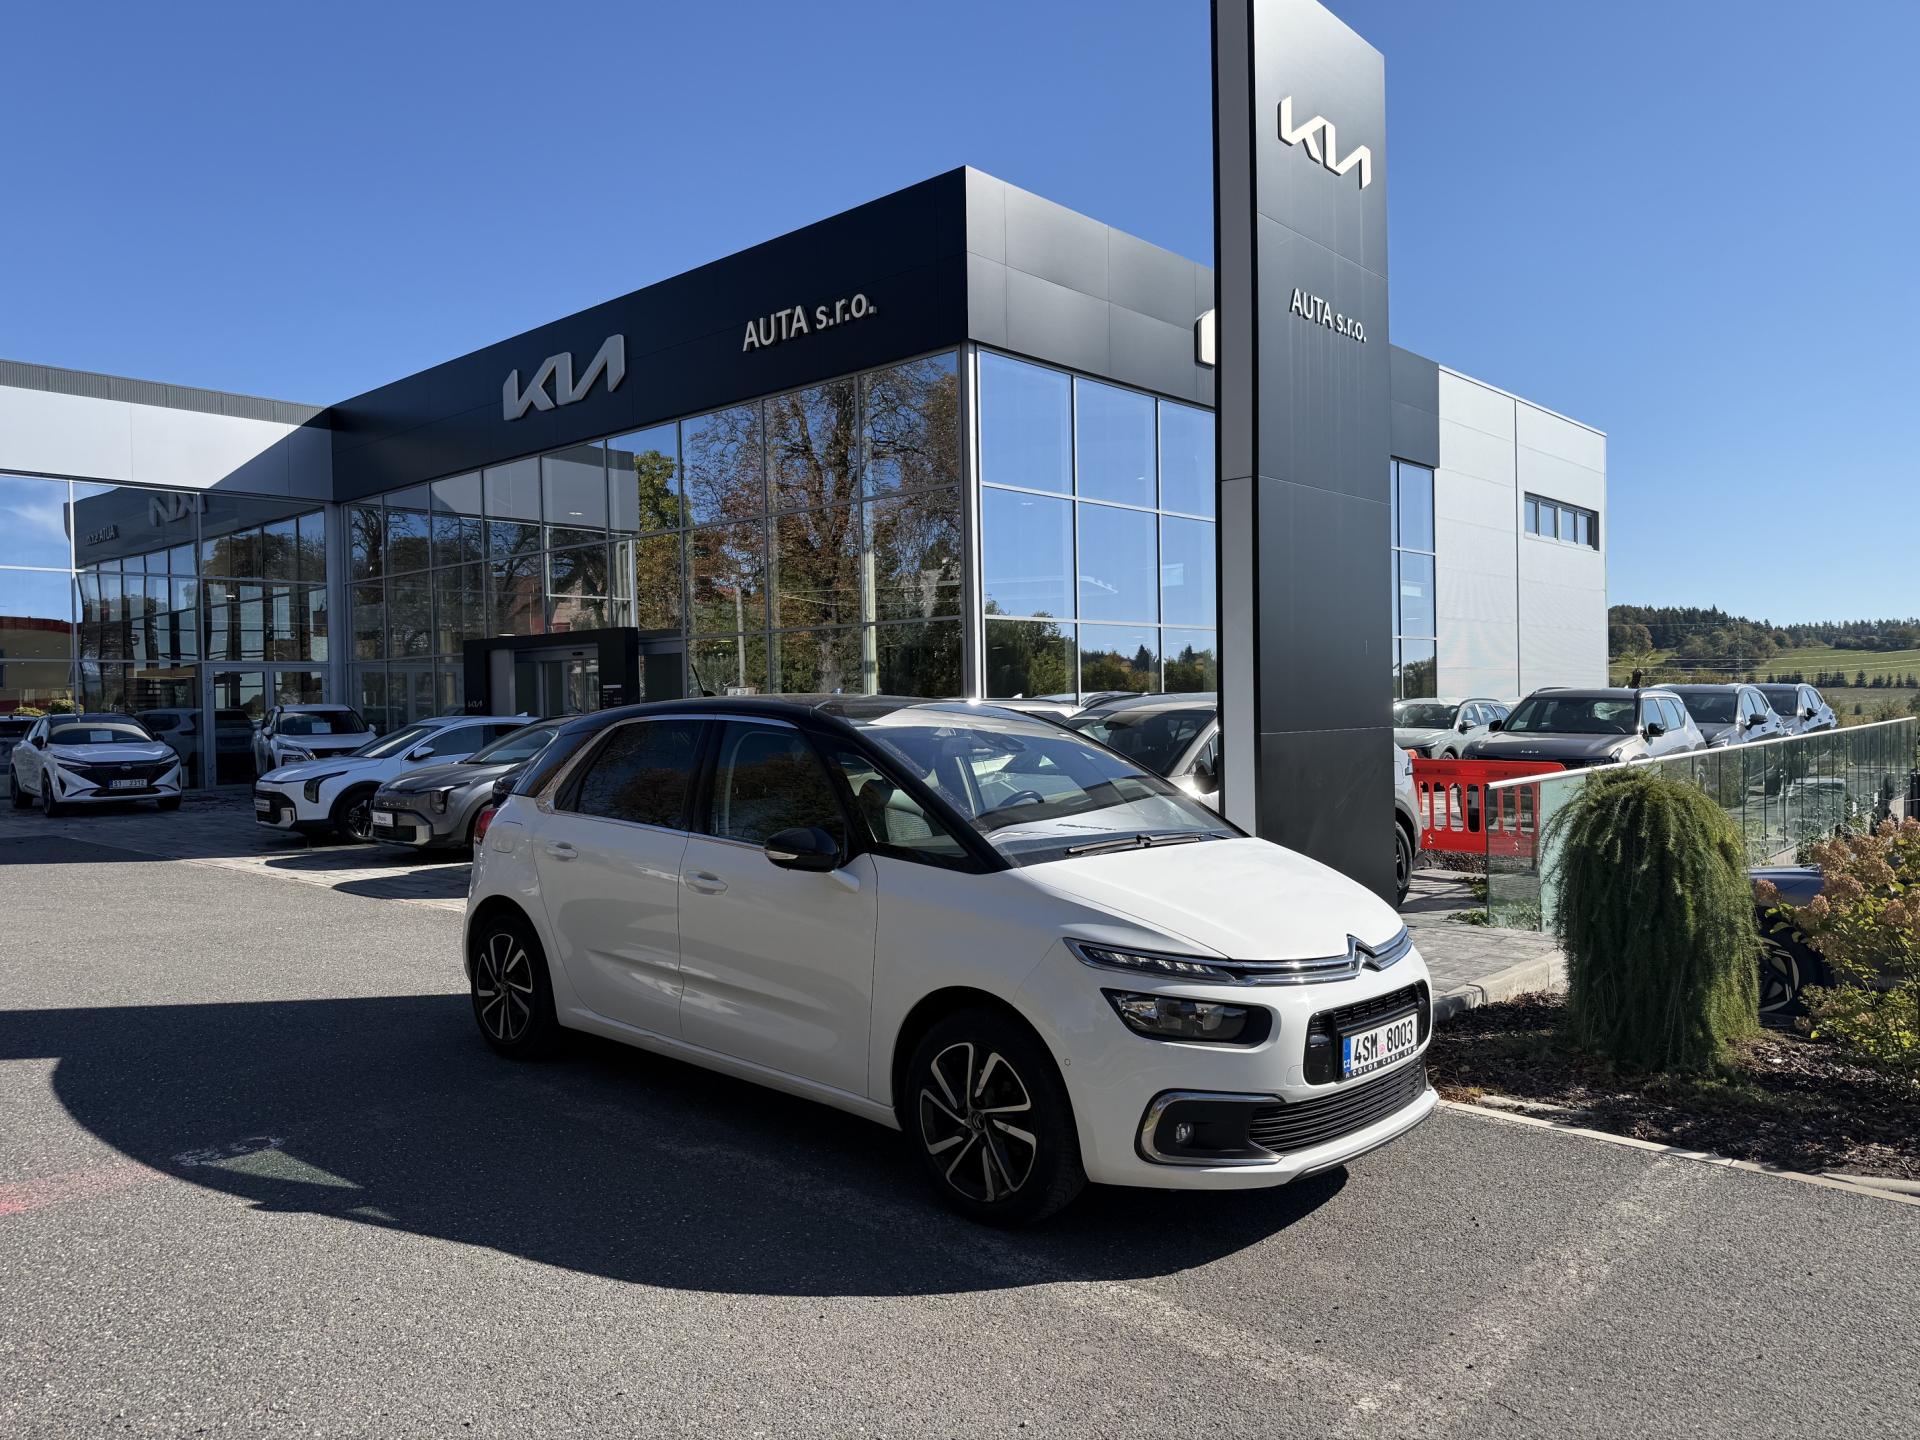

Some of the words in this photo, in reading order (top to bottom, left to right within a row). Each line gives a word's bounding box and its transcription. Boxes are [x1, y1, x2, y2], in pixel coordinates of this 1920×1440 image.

[743, 305, 809, 352] AUTA
[816, 294, 874, 329] s.r.o.
[1290, 288, 1333, 328] AUTA
[1336, 314, 1366, 342] s.r.o.
[1354, 1033, 1378, 1064] 4SM
[1387, 1020, 1413, 1053] 8003
